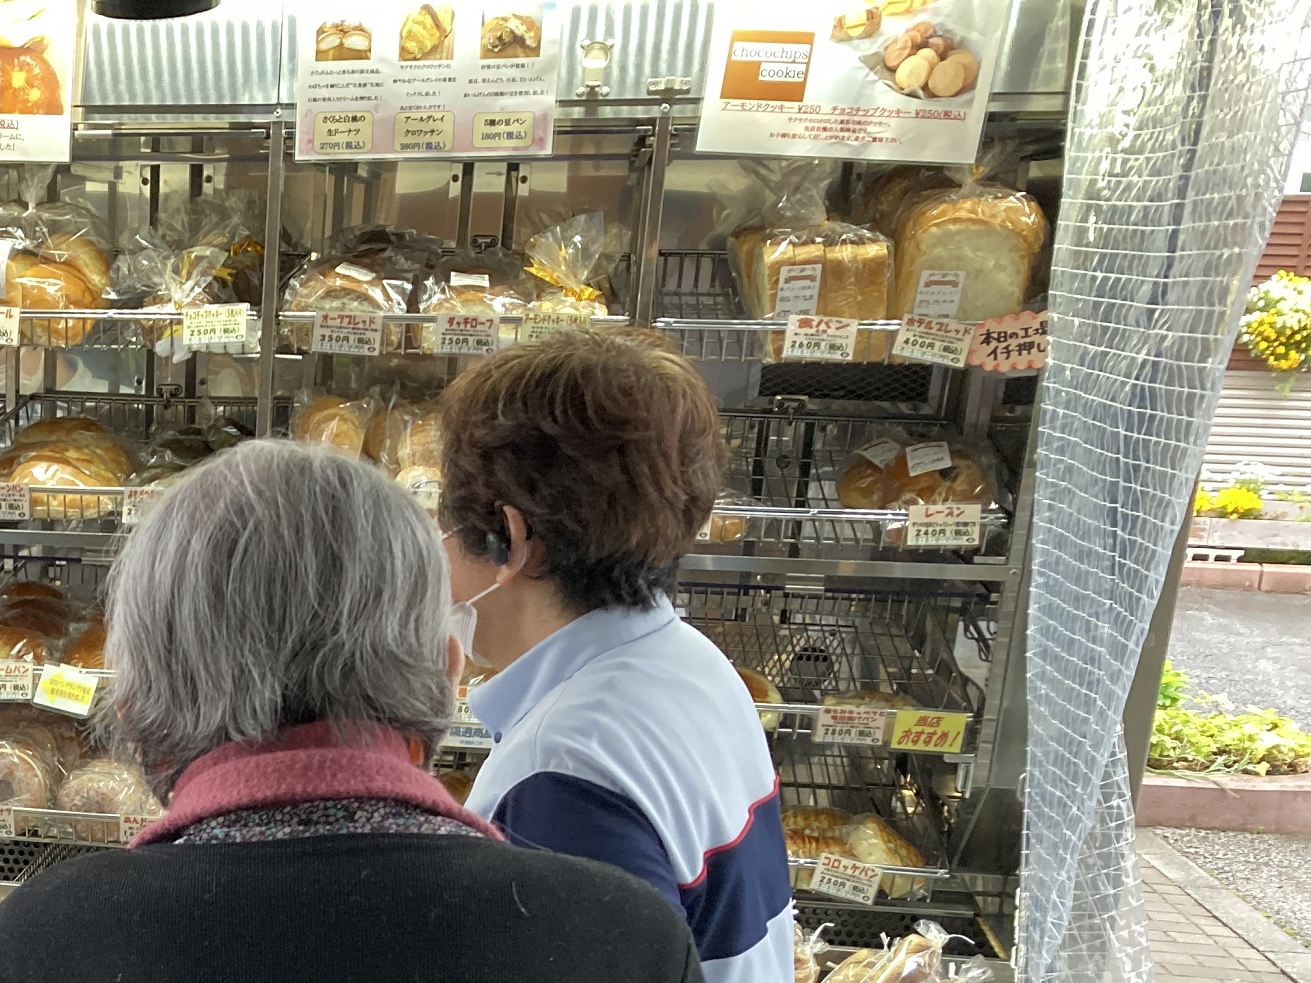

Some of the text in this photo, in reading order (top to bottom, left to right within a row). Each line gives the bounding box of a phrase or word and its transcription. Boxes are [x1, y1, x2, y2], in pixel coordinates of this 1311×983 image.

[733, 43, 808, 63] chocochips
[760, 63, 804, 79] cookie
[721, 101, 794, 112] アーモンドクッキー
[798, 105, 821, 114] ¥250
[830, 105, 912, 117] チョコチップクッキー
[404, 115, 445, 123] アールグレイ
[326, 128, 360, 136] 生ドーナツ
[404, 129, 443, 137] クロワッサン
[321, 313, 376, 326] オーツブレッド
[447, 316, 494, 329] ダッチローフ
[797, 317, 850, 331] 食パン
[906, 316, 972, 337] ホテルブレッド
[924, 507, 965, 519] レーズン
[914, 715, 945, 728] 当店
[123, 816, 156, 826] あんドー
[822, 856, 879, 879] コロッケパン
